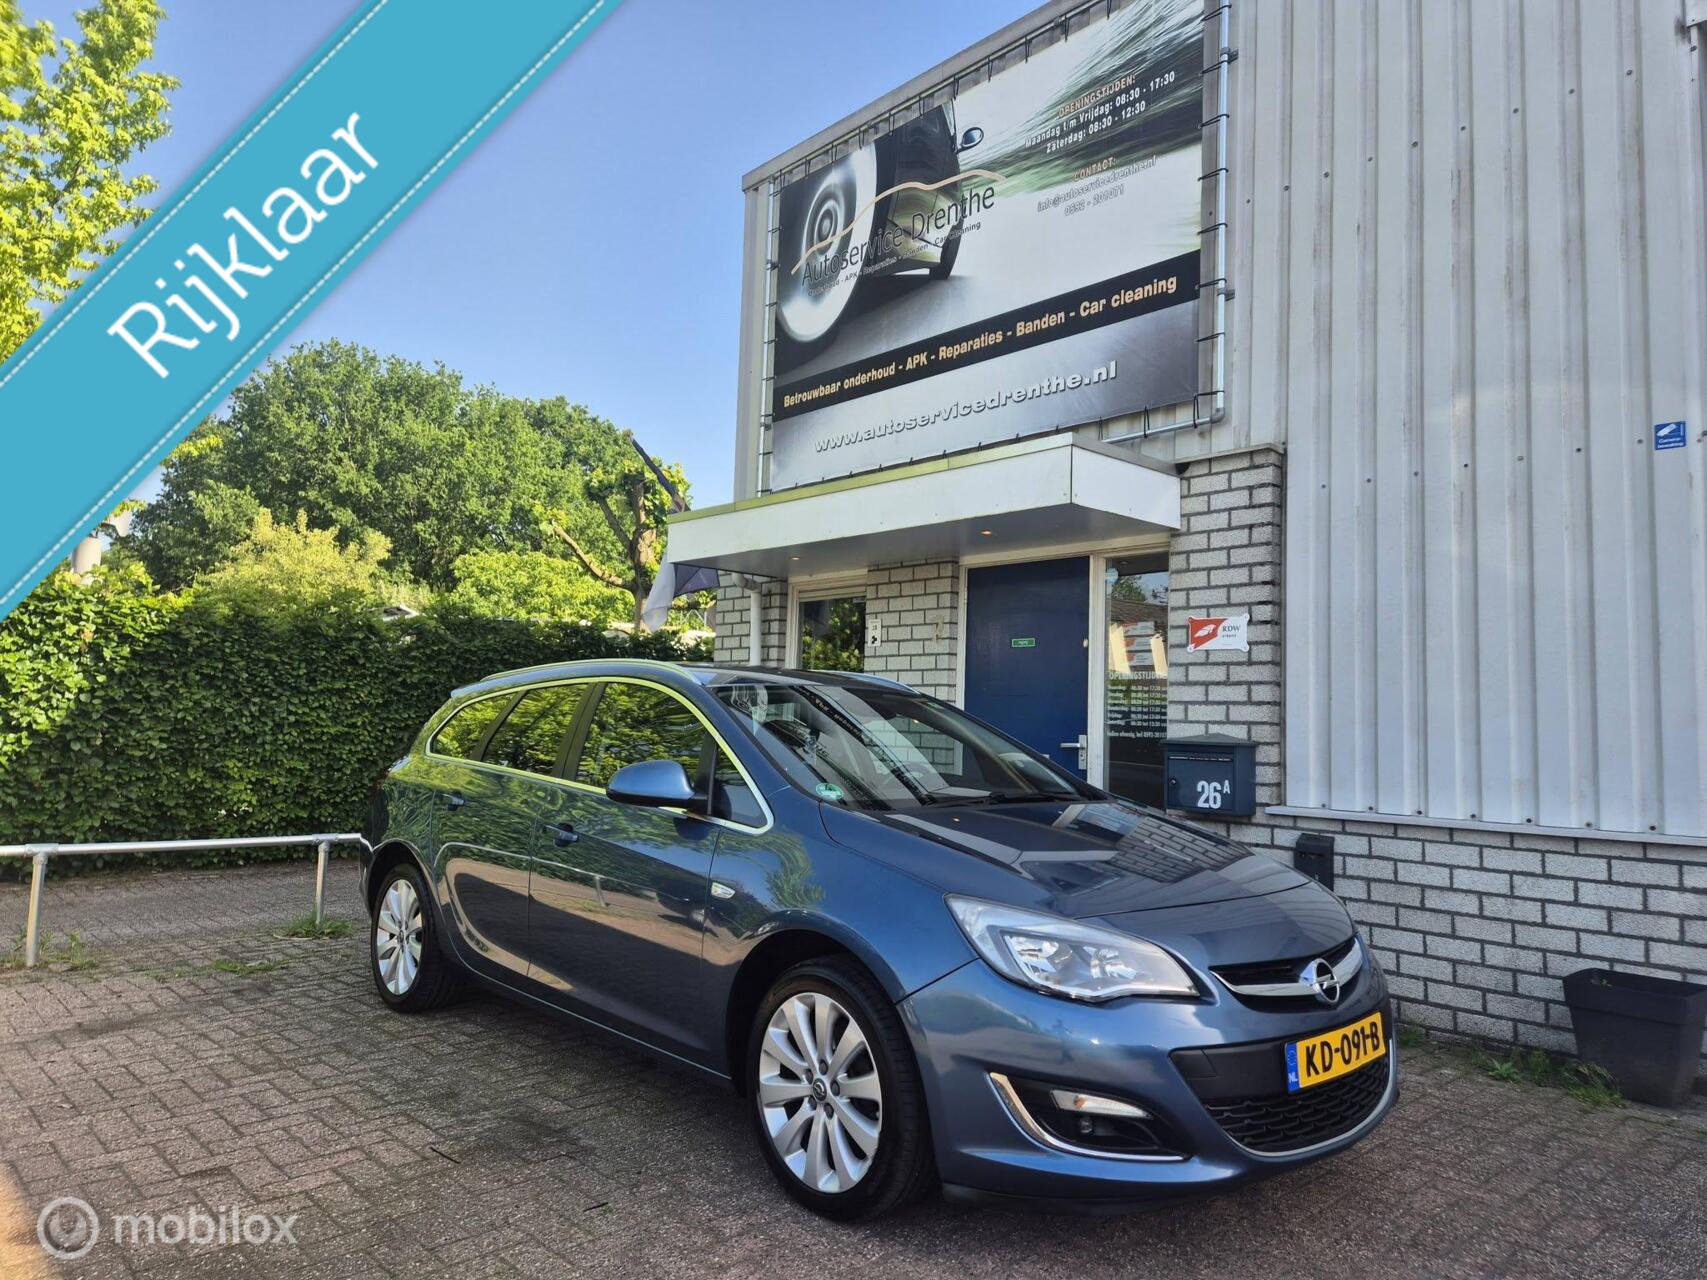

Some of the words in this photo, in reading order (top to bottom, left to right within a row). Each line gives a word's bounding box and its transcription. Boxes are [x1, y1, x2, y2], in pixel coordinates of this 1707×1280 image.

[1024, 127, 1061, 148] Maandag
[1079, 102, 1113, 124] Vrijdag:
[1115, 87, 1141, 108] 08:30
[1150, 70, 1176, 91] 17:30
[1046, 130, 1086, 154] Zaterdag:
[1088, 116, 1112, 134] 08:30
[1121, 100, 1147, 119] 12:30
[1058, 74, 1137, 118] OPENINGSTIJDEN:
[1073, 156, 1116, 182] CONTACT:
[802, 227, 903, 286] Autoservice
[911, 186, 996, 241] Drenthe
[783, 381, 841, 408] Betrouwbaar
[843, 361, 896, 390] onderhoud
[905, 351, 929, 371] APK
[938, 330, 1003, 361] Reparaties
[1016, 310, 1066, 337] Banden
[1079, 298, 1107, 317] Car
[1111, 276, 1178, 308] cleaning
[814, 360, 1119, 453] www.autoservicedrenthe.nl
[1288, 1071, 1298, 1084] NL
[1305, 1021, 1380, 1078] KD-091-B
